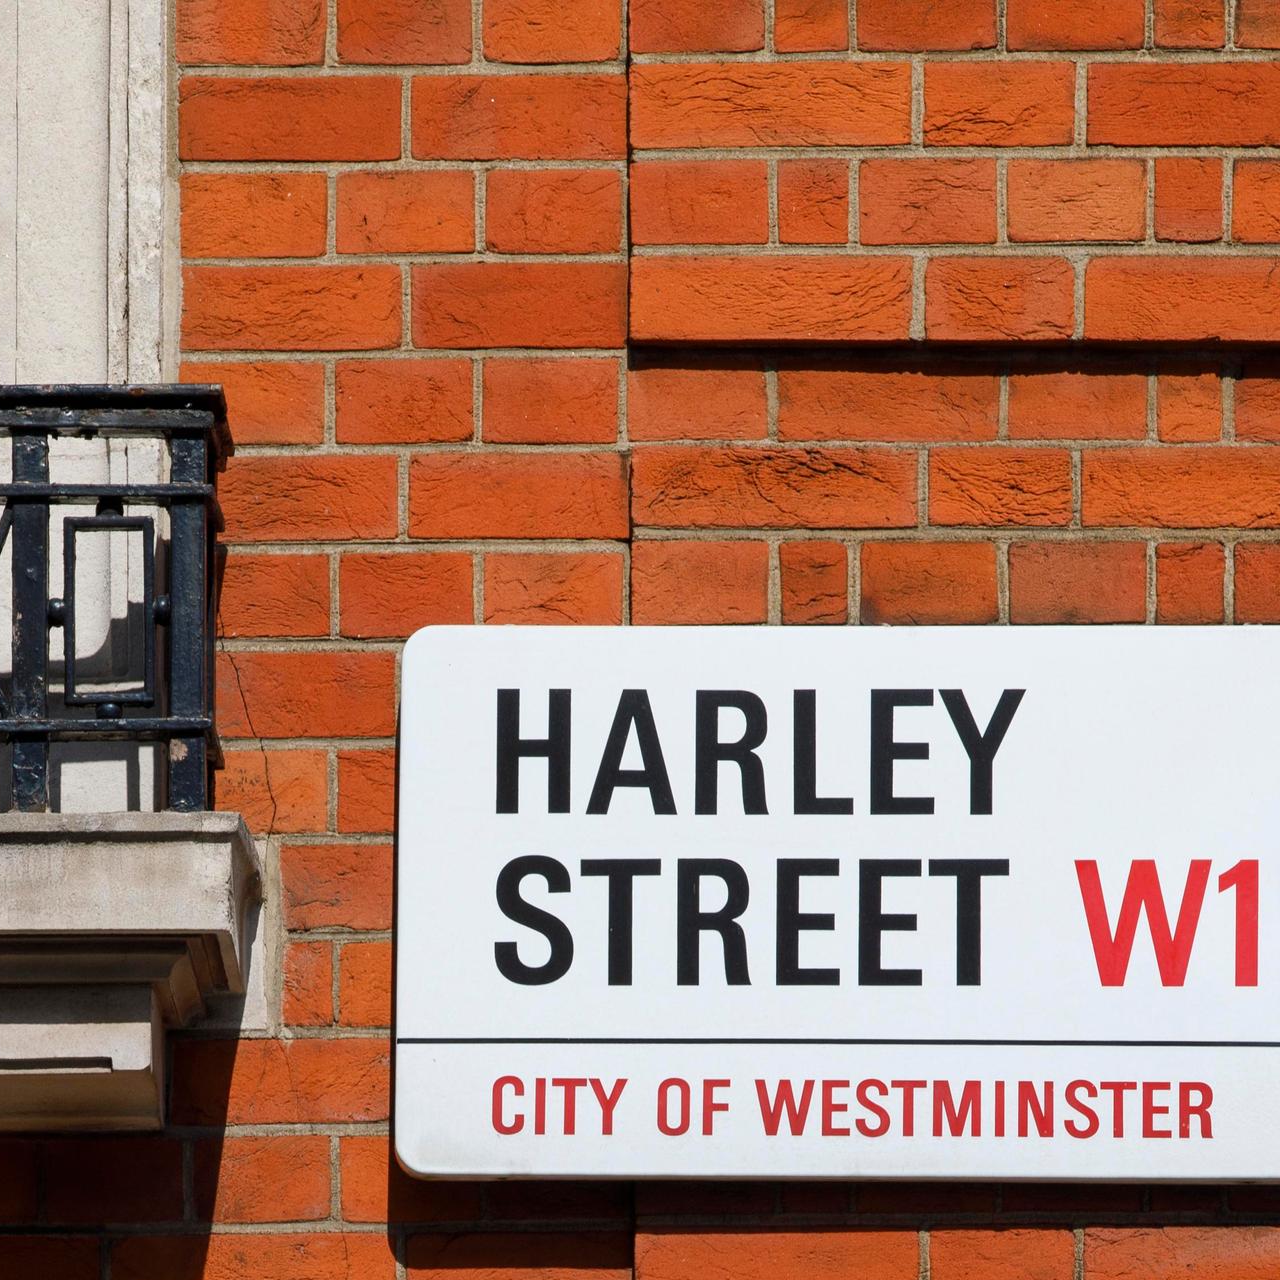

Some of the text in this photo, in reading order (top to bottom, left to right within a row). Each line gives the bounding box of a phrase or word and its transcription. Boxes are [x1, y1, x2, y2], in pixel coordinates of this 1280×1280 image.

[495, 688, 1026, 816] HARLEY
[493, 854, 1260, 988] STREET W1
[491, 1074, 1214, 1139] CITY OF WESTMINSTER
